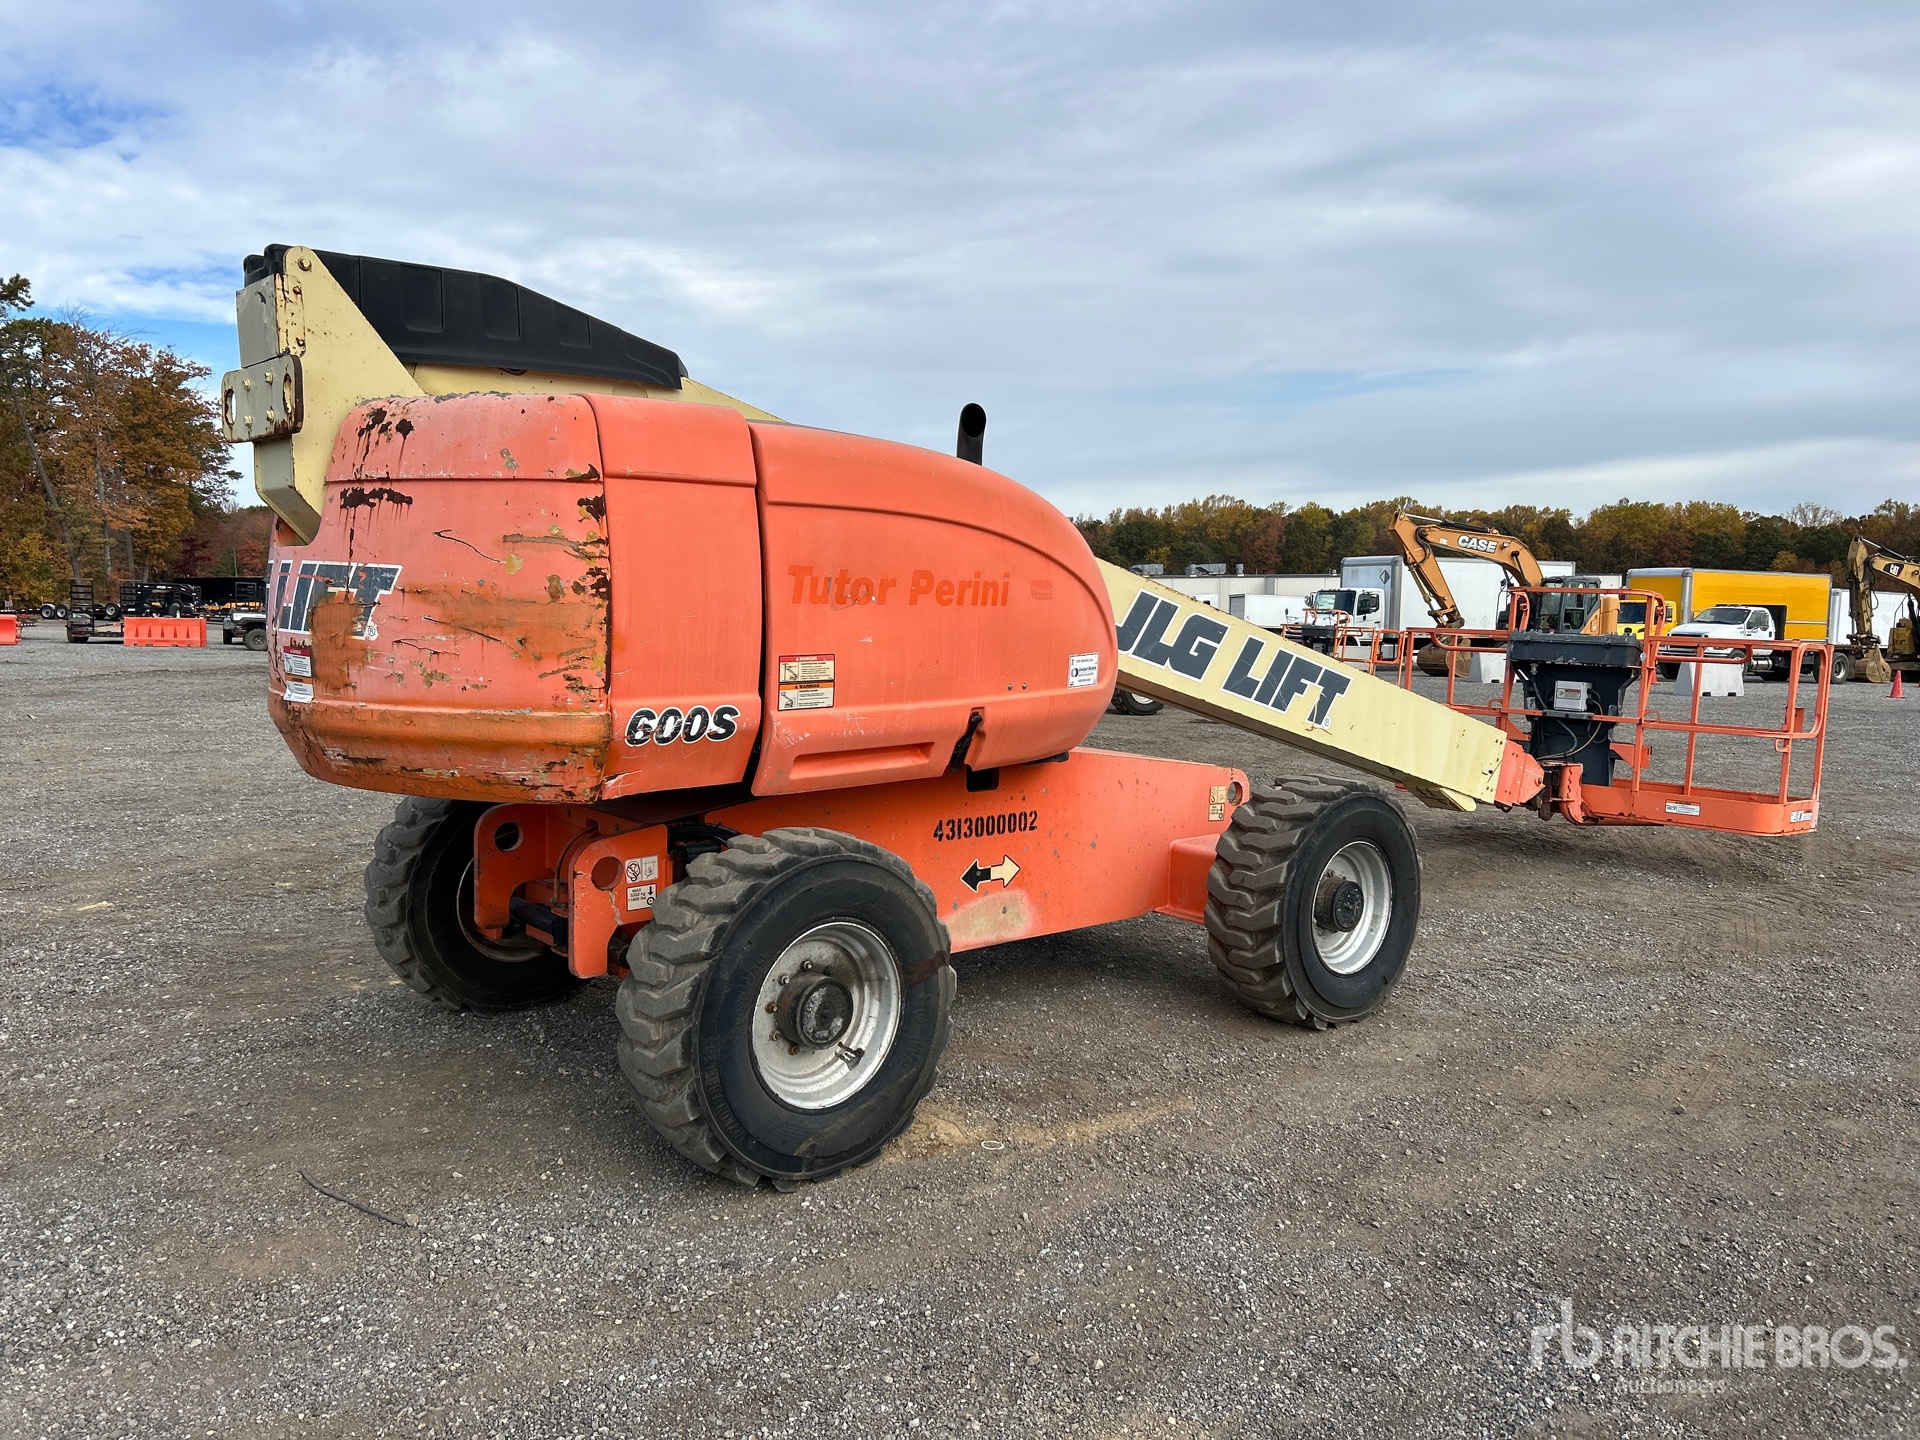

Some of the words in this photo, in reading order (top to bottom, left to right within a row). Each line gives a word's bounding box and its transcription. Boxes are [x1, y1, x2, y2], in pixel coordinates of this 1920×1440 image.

[1457, 534, 1498, 554] CASE
[788, 565, 897, 605] Tutor
[909, 569, 1010, 606] Perini
[1889, 563, 1900, 576] CAT
[1116, 588, 1231, 682] JLG
[1220, 634, 1353, 726] LIFT
[624, 705, 741, 747] 600S
[933, 810, 1038, 842] 4313000002
